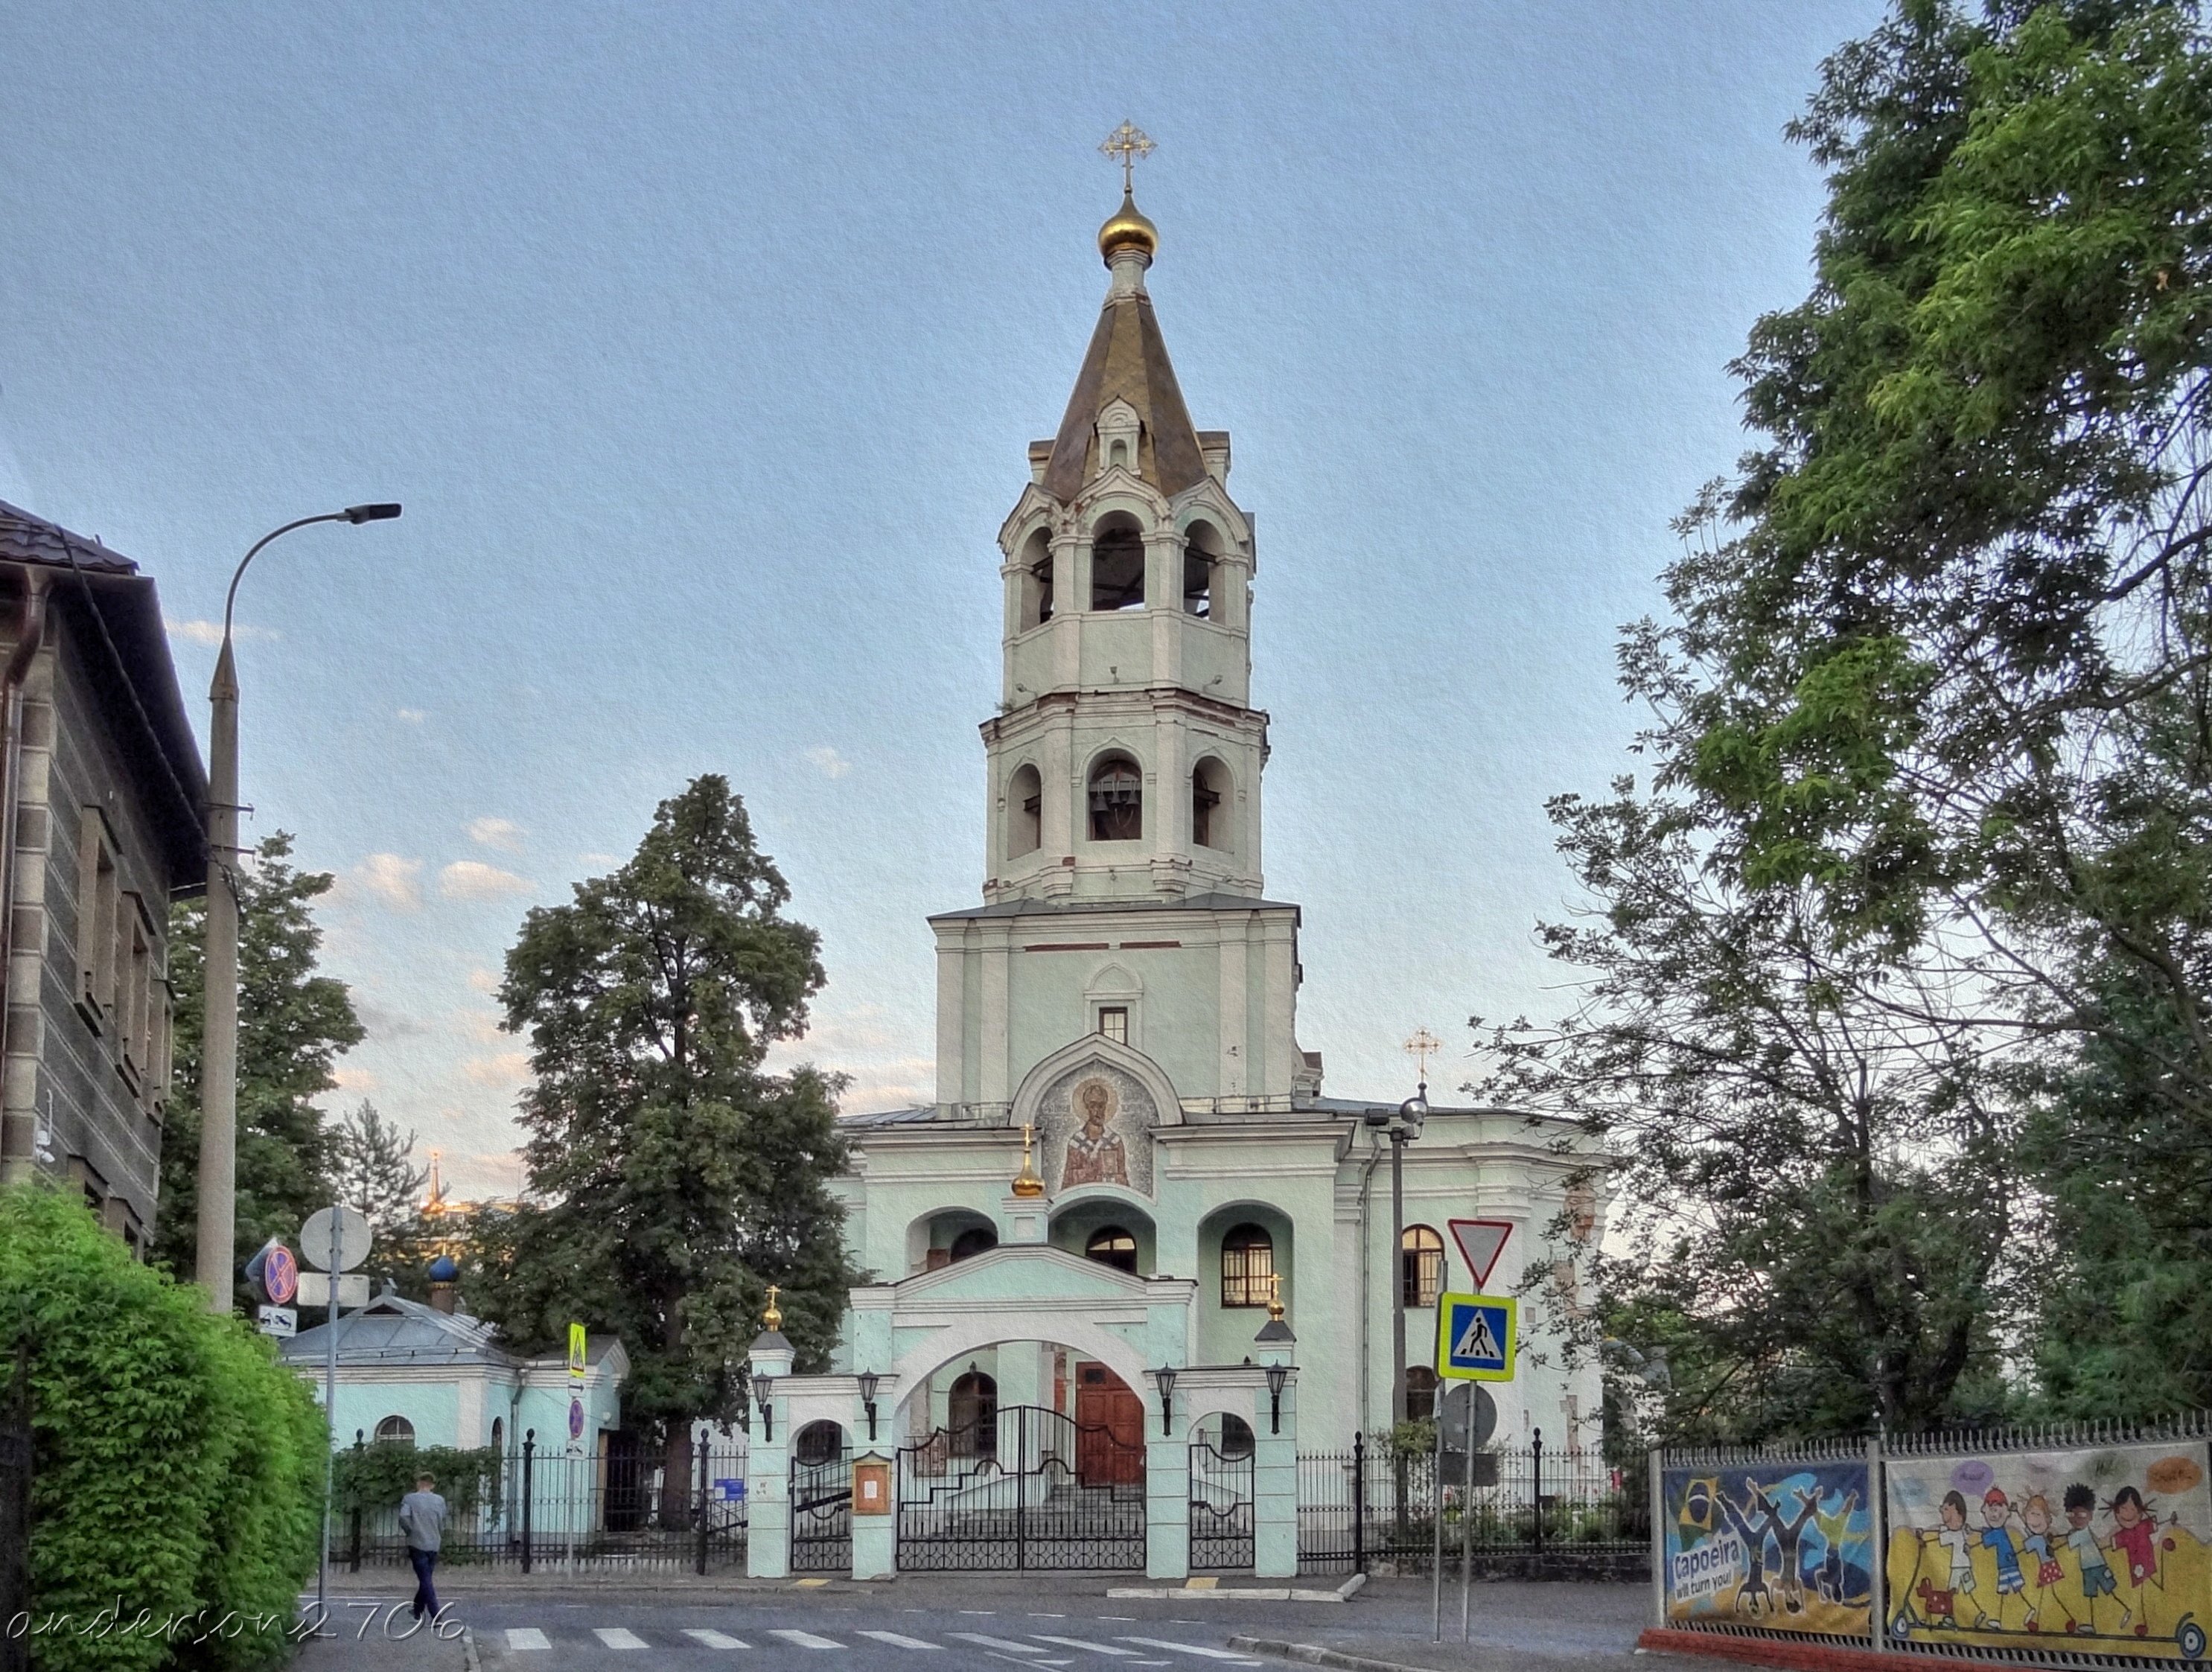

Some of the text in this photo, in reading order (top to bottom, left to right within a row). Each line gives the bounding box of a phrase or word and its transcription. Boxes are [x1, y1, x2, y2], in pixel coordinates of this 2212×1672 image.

[1676, 1569, 1733, 1599] will turn you!
